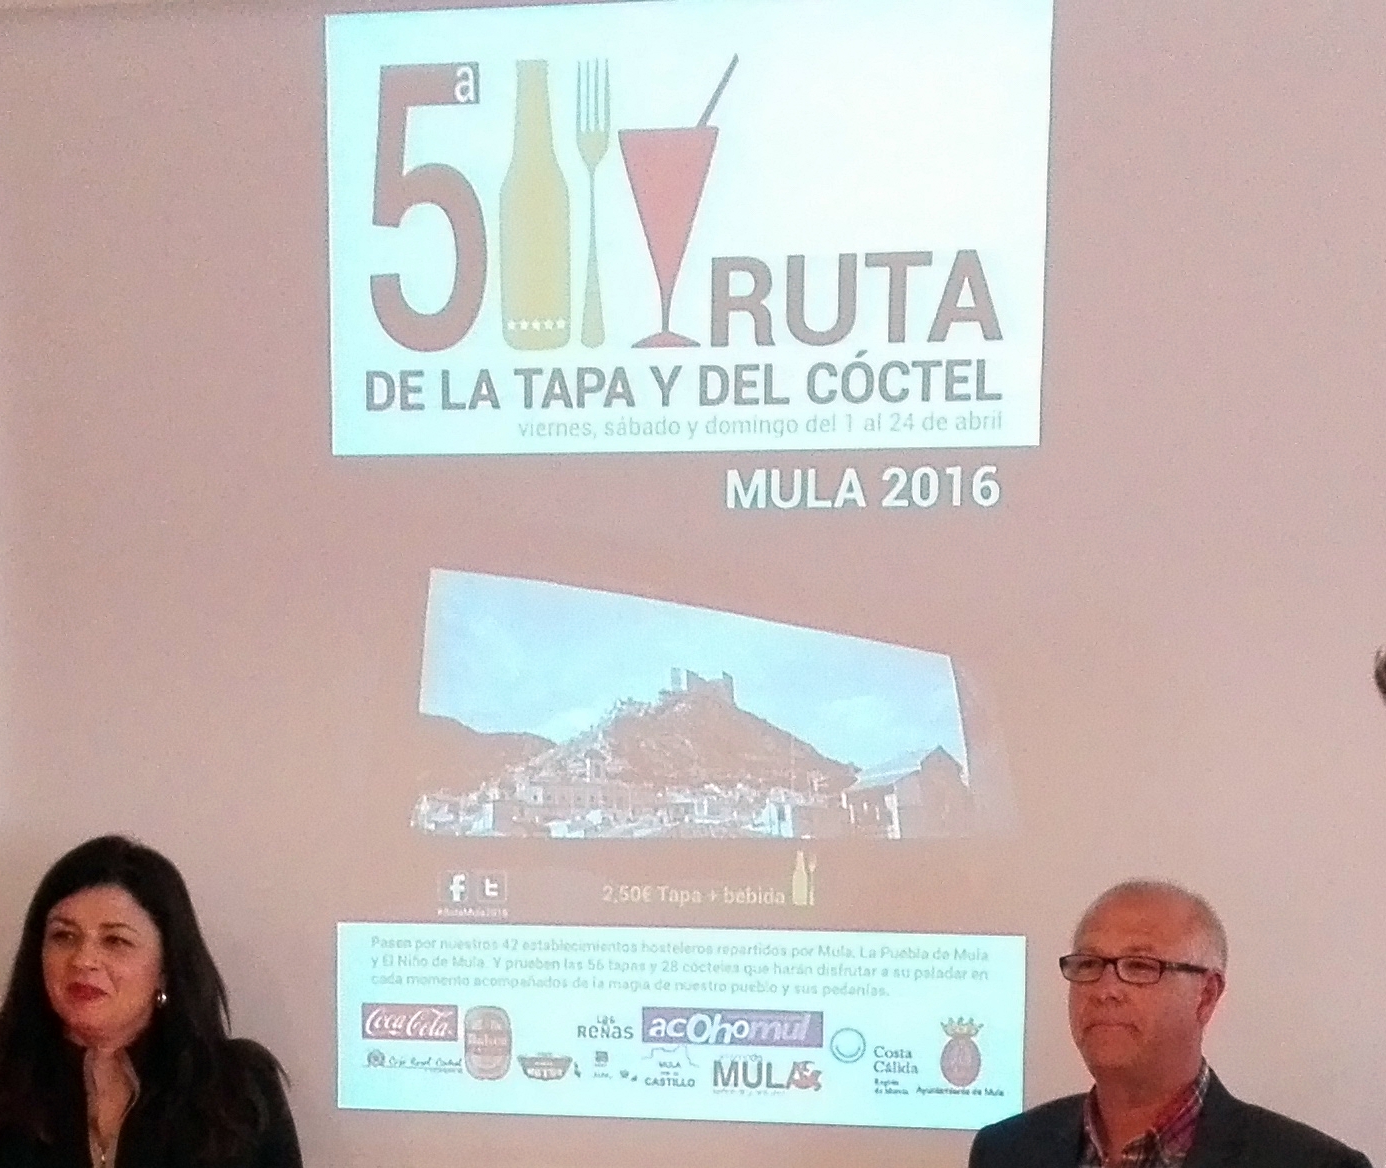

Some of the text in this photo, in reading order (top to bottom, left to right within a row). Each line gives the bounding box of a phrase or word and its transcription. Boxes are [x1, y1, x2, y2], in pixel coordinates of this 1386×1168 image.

[710, 249, 1004, 348] RUTA
[365, 351, 1003, 413] DE LA TAPA Y DEL CÓCTEL
[518, 409, 1003, 440] viernes, sábado y domingo del 1 al 24 de abril
[725, 465, 1001, 509] MULA 2016
[656, 885, 703, 908] Tapa
[723, 885, 786, 905] bebida
